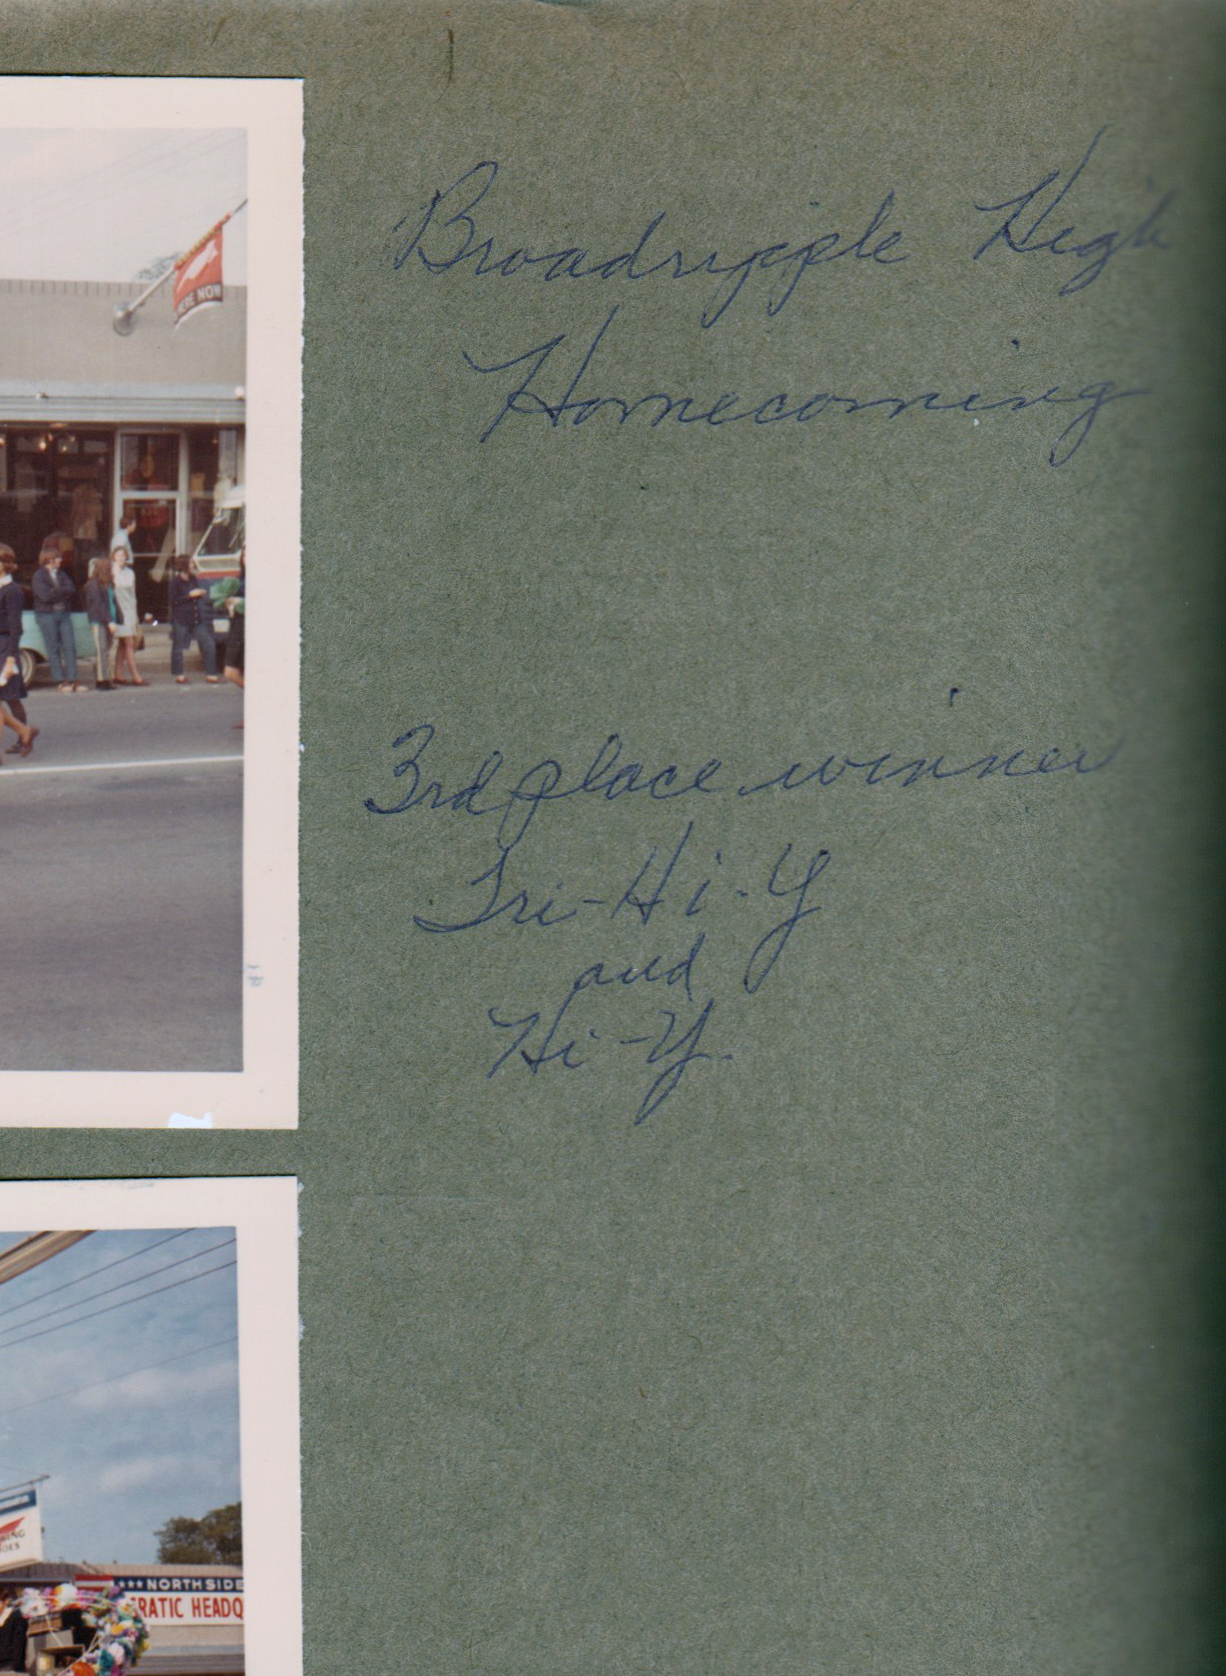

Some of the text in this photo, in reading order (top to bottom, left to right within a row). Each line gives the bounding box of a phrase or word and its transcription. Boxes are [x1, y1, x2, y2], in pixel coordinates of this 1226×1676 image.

[462, 306, 1155, 467] Homecoming
[365, 723, 506, 816] 3rd
[507, 734, 720, 851] place
[574, 933, 705, 996] and
[131, 1597, 184, 1618] RATIC
